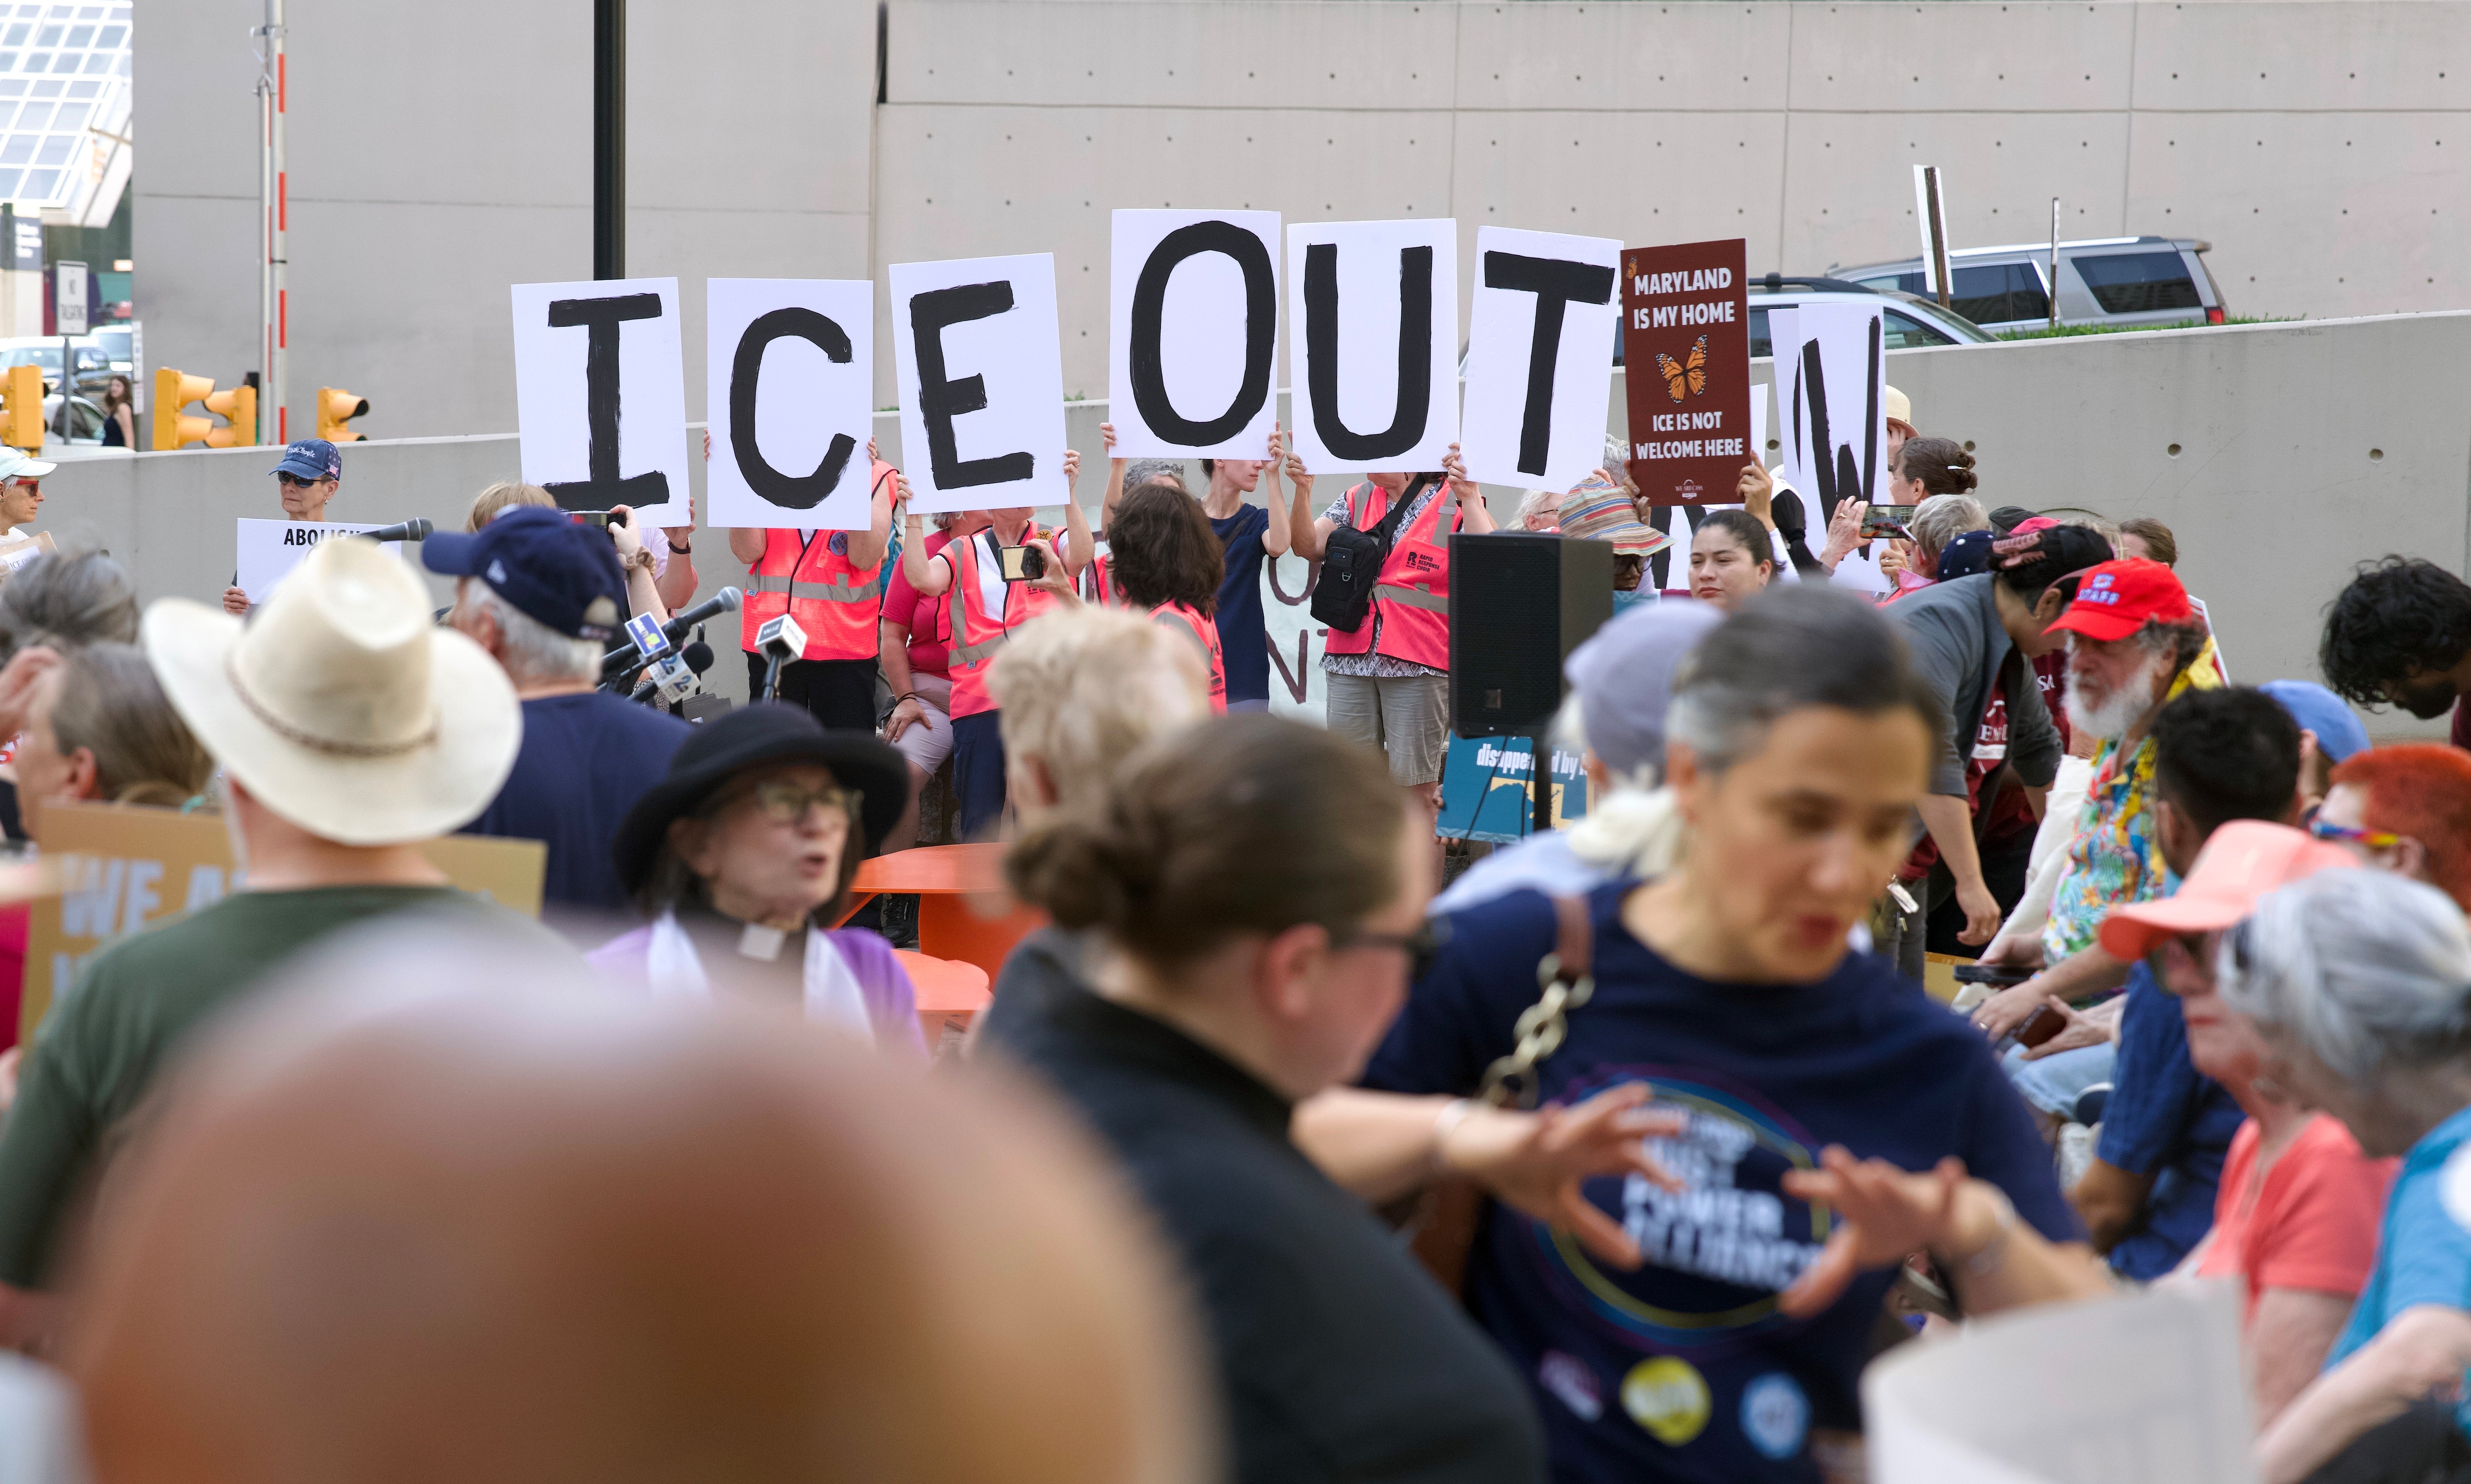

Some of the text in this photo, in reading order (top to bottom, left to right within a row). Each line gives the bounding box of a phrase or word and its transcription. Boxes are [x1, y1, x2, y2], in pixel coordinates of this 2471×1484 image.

[1634, 267, 1732, 296] MARYLAND
[1633, 300, 1735, 329] IS MY HOME
[543, 280, 1034, 511] ICE
[1130, 220, 1615, 476] OUT
[1653, 411, 1722, 431] ICE IS NOT
[1636, 438, 1743, 460] WELCOME HERE
[9, 559, 21, 570] ICE
[1418, 560, 1440, 570] RESPONSE
[2077, 588, 2120, 605] STAFF
[674, 675, 691, 689] 2
[1560, 751, 1578, 780] by
